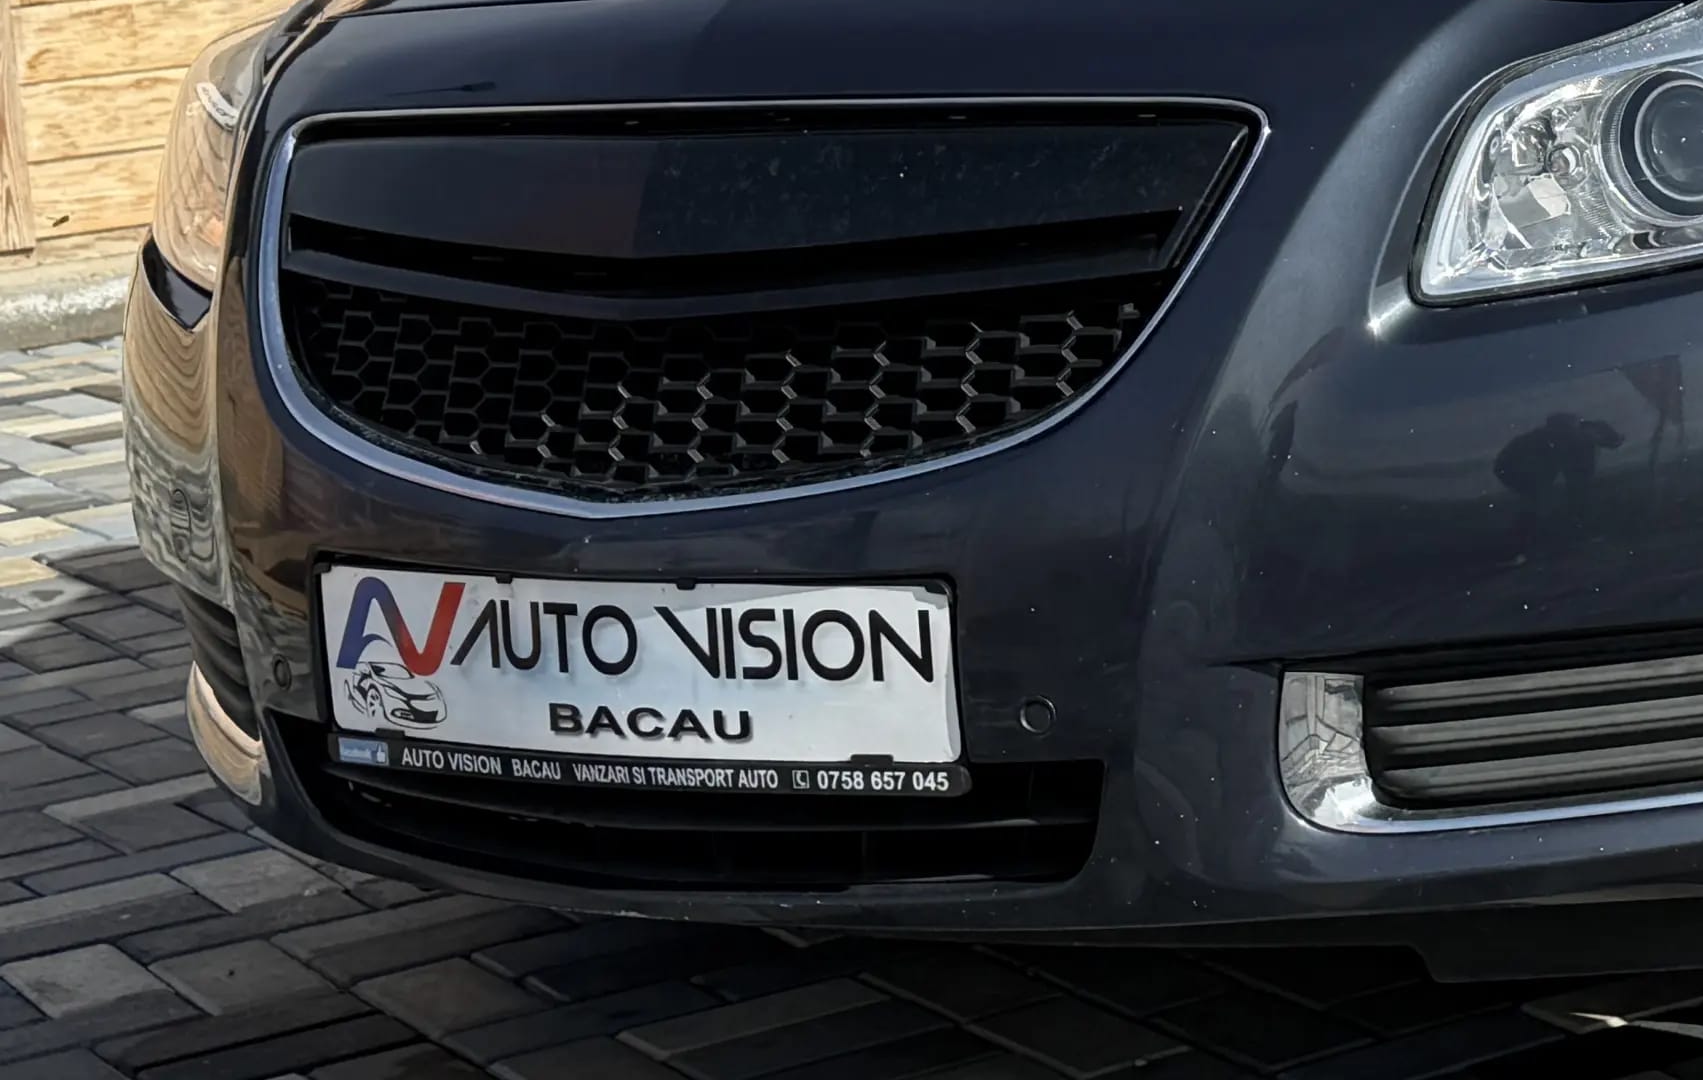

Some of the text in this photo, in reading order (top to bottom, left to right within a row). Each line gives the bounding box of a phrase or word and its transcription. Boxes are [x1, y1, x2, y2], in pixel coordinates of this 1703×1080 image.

[450, 598, 934, 683] AUTO VISION
[548, 702, 751, 742] BACAU
[401, 747, 949, 791] AUTO VISION BACAU VANZARI SI TRANSPORT AUTO 0758 657 045
